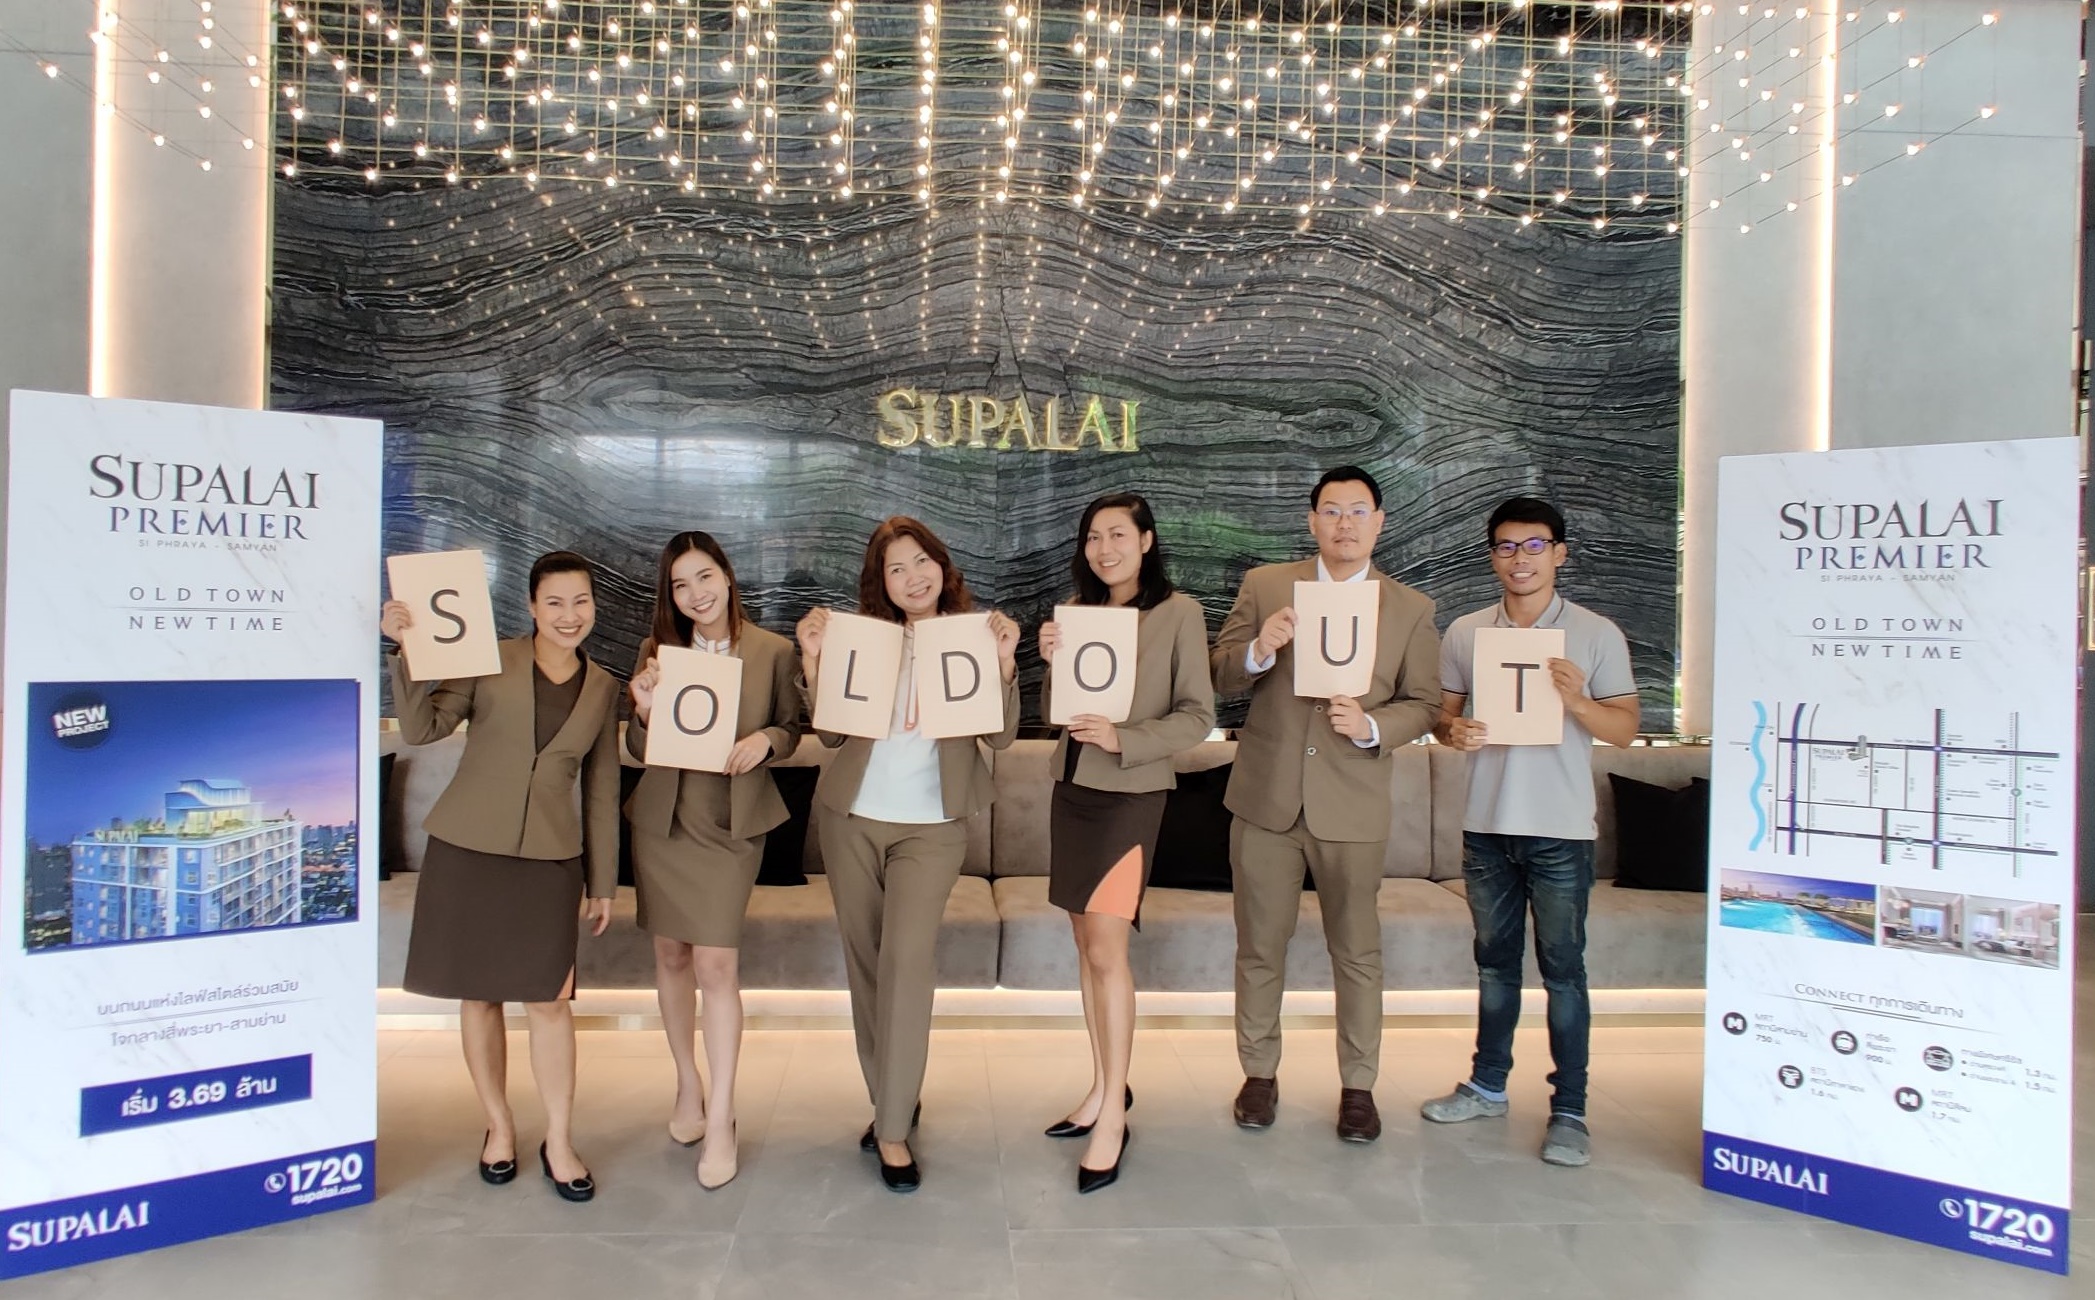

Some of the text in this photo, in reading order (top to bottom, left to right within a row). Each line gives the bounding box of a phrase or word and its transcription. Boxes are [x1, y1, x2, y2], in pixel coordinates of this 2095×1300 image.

[877, 384, 1141, 452] SUPALAI
[89, 454, 321, 509] SUPALAI
[108, 506, 309, 540] PREMIER
[1779, 497, 2004, 541] SUPALAI
[138, 539, 149, 547] SI
[157, 540, 206, 549] PHRAYA
[227, 542, 277, 552] SAMYAN
[1795, 543, 1991, 570] PREMIER
[129, 587, 285, 603] OLD TOWN
[1820, 574, 1830, 583] SI
[1837, 574, 1883, 582] PHRAYA
[1903, 574, 1955, 582] SAMYAN
[129, 616, 283, 631] NEW TIME
[429, 588, 467, 644] S
[1812, 617, 1963, 632] OLD TOWN
[1320, 615, 1358, 667] U
[1811, 643, 1961, 660] NEW TIME
[842, 649, 869, 702] L
[942, 650, 981, 703] D
[1073, 641, 1117, 693] O
[1500, 662, 1541, 713] T
[53, 704, 107, 729] NEW
[57, 720, 110, 738] PROJECT
[672, 684, 720, 736] O
[1795, 983, 1866, 1004] CONNECT
[121, 1075, 277, 1117] เริ่ม 3.69 ล้าน
[286, 1153, 363, 1193] 1720
[1713, 1147, 1829, 1195] SUPALAI
[291, 1183, 363, 1206] supalai.com
[7, 1201, 150, 1252] SUPALAI
[1964, 1199, 2053, 1242] 1720
[1969, 1229, 2053, 1257] supalai.com
